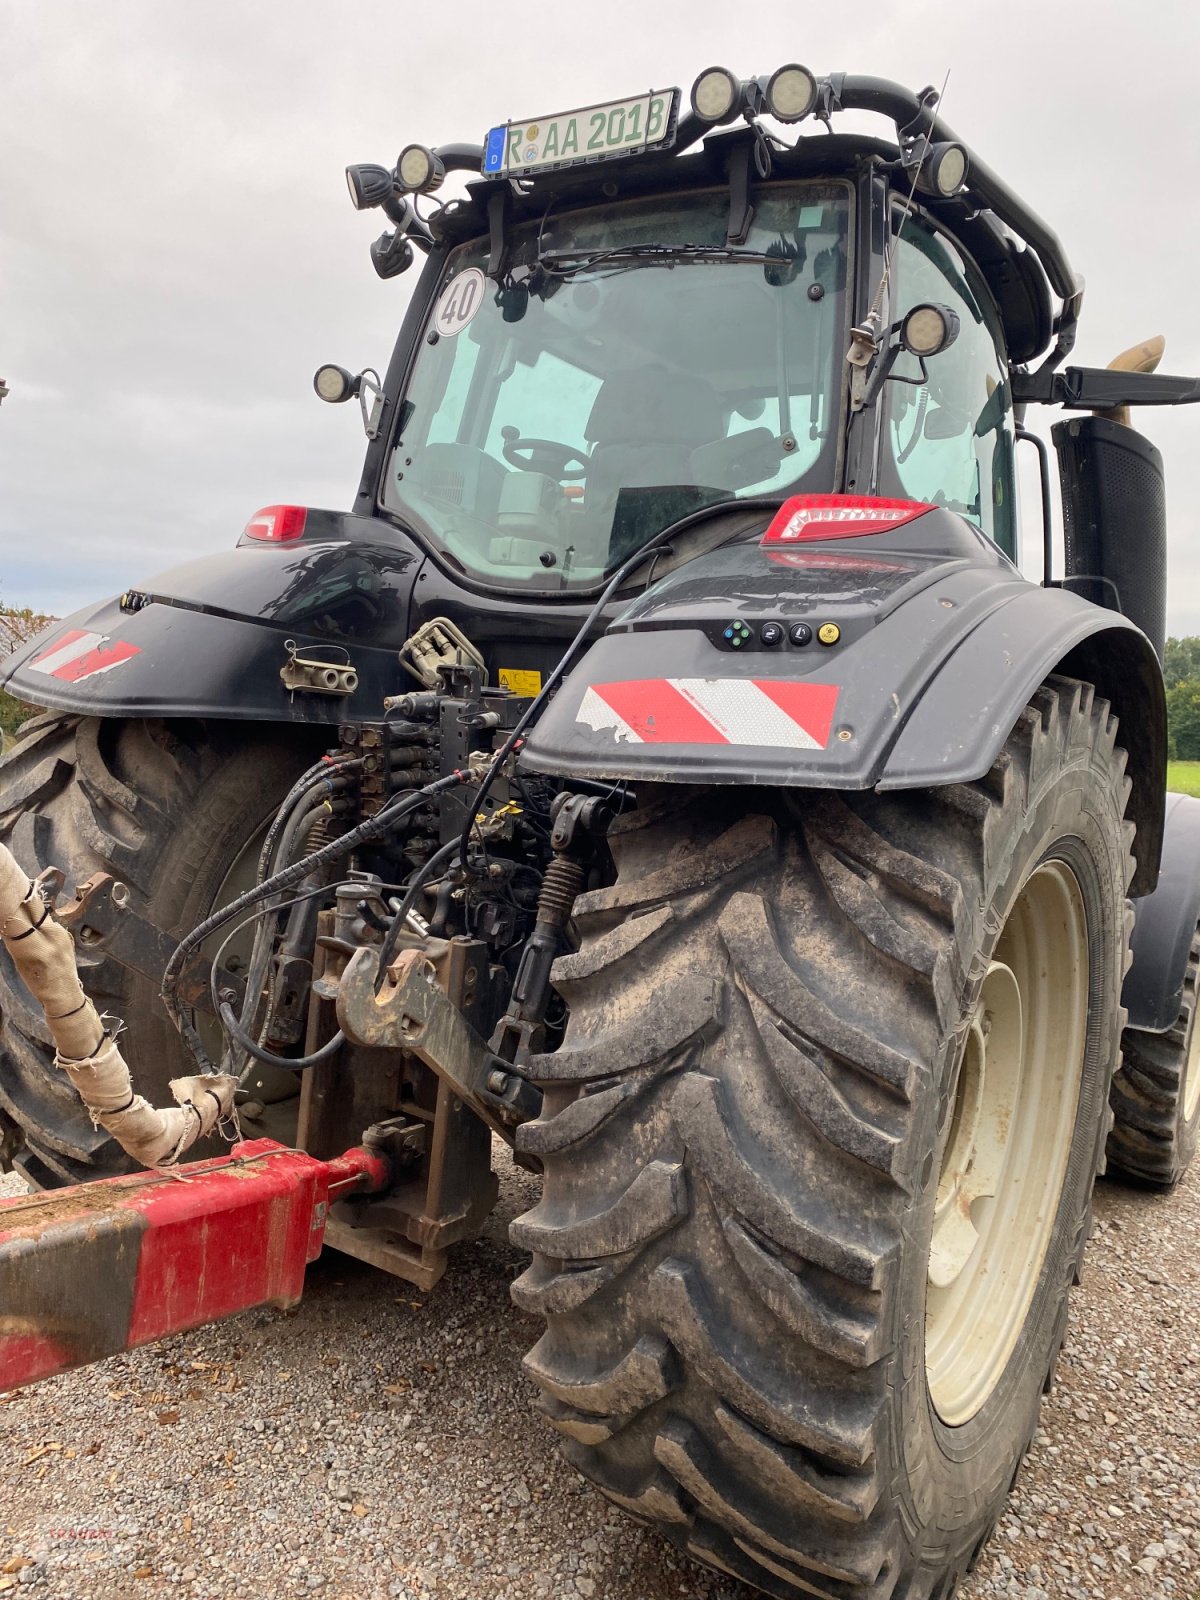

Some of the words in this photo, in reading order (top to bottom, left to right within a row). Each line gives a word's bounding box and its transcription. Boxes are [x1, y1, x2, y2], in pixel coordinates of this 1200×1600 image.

[504, 129, 523, 165] R
[542, 118, 578, 158] AA
[587, 98, 664, 150] 2018
[491, 154, 498, 165] D
[441, 279, 478, 324] 40
